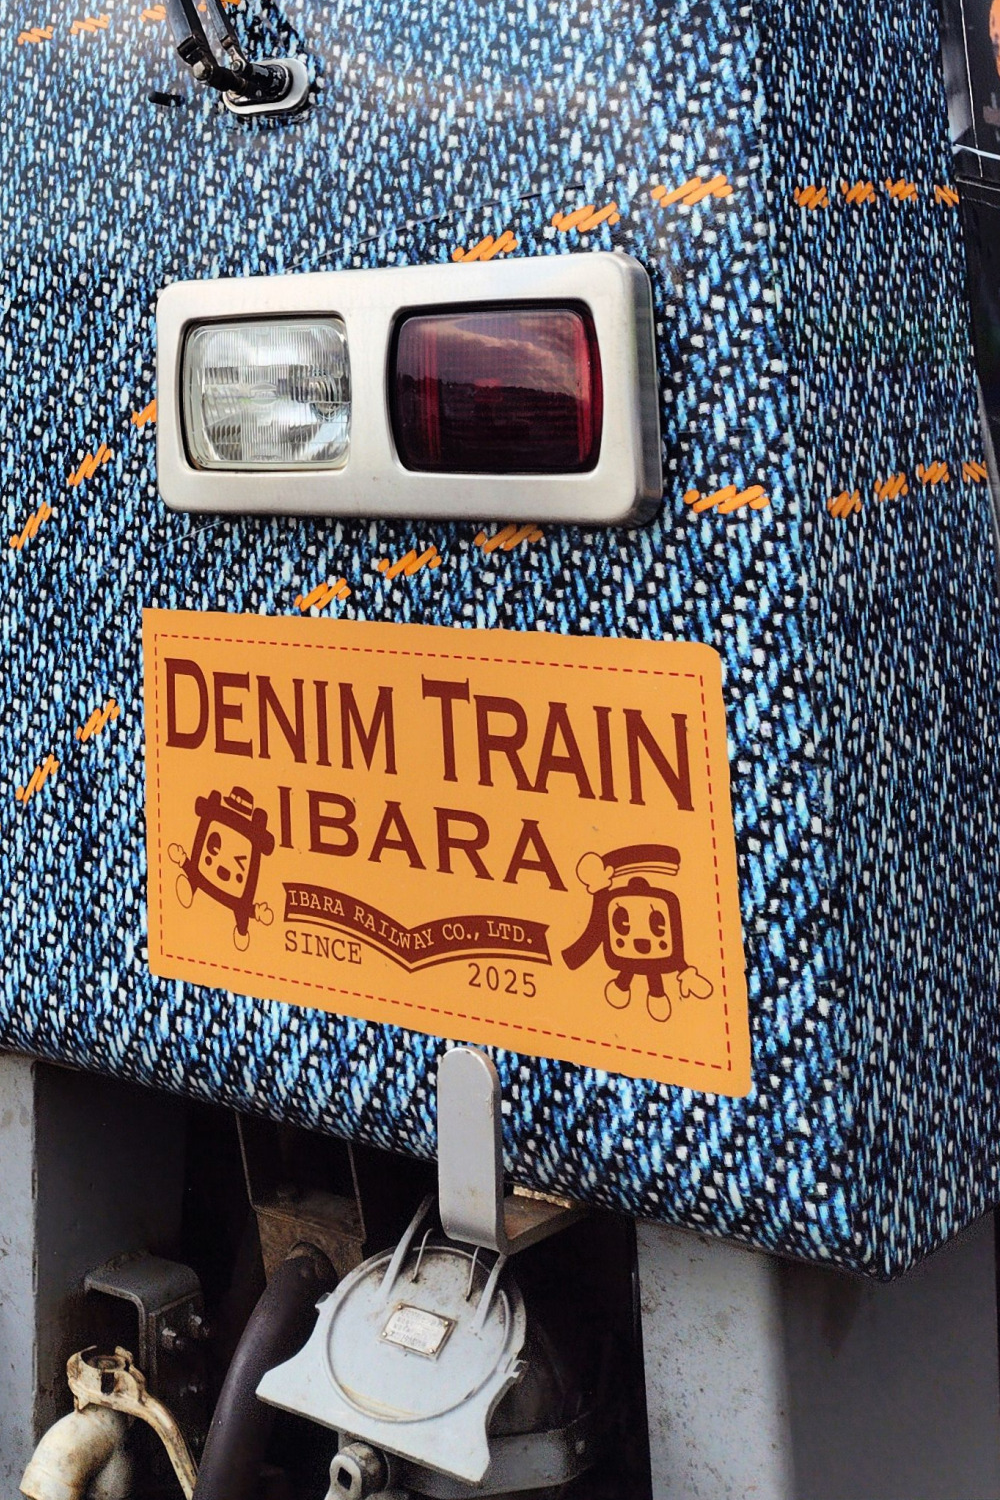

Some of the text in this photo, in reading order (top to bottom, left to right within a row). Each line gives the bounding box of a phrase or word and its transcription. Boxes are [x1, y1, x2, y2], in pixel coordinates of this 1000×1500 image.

[164, 657, 695, 812] DENIM TRAIN
[276, 785, 569, 893] IBARA
[284, 929, 362, 965] SINCE
[288, 889, 533, 950] IBARA RAILWAY CO., LTD.
[467, 962, 537, 998] 2025
